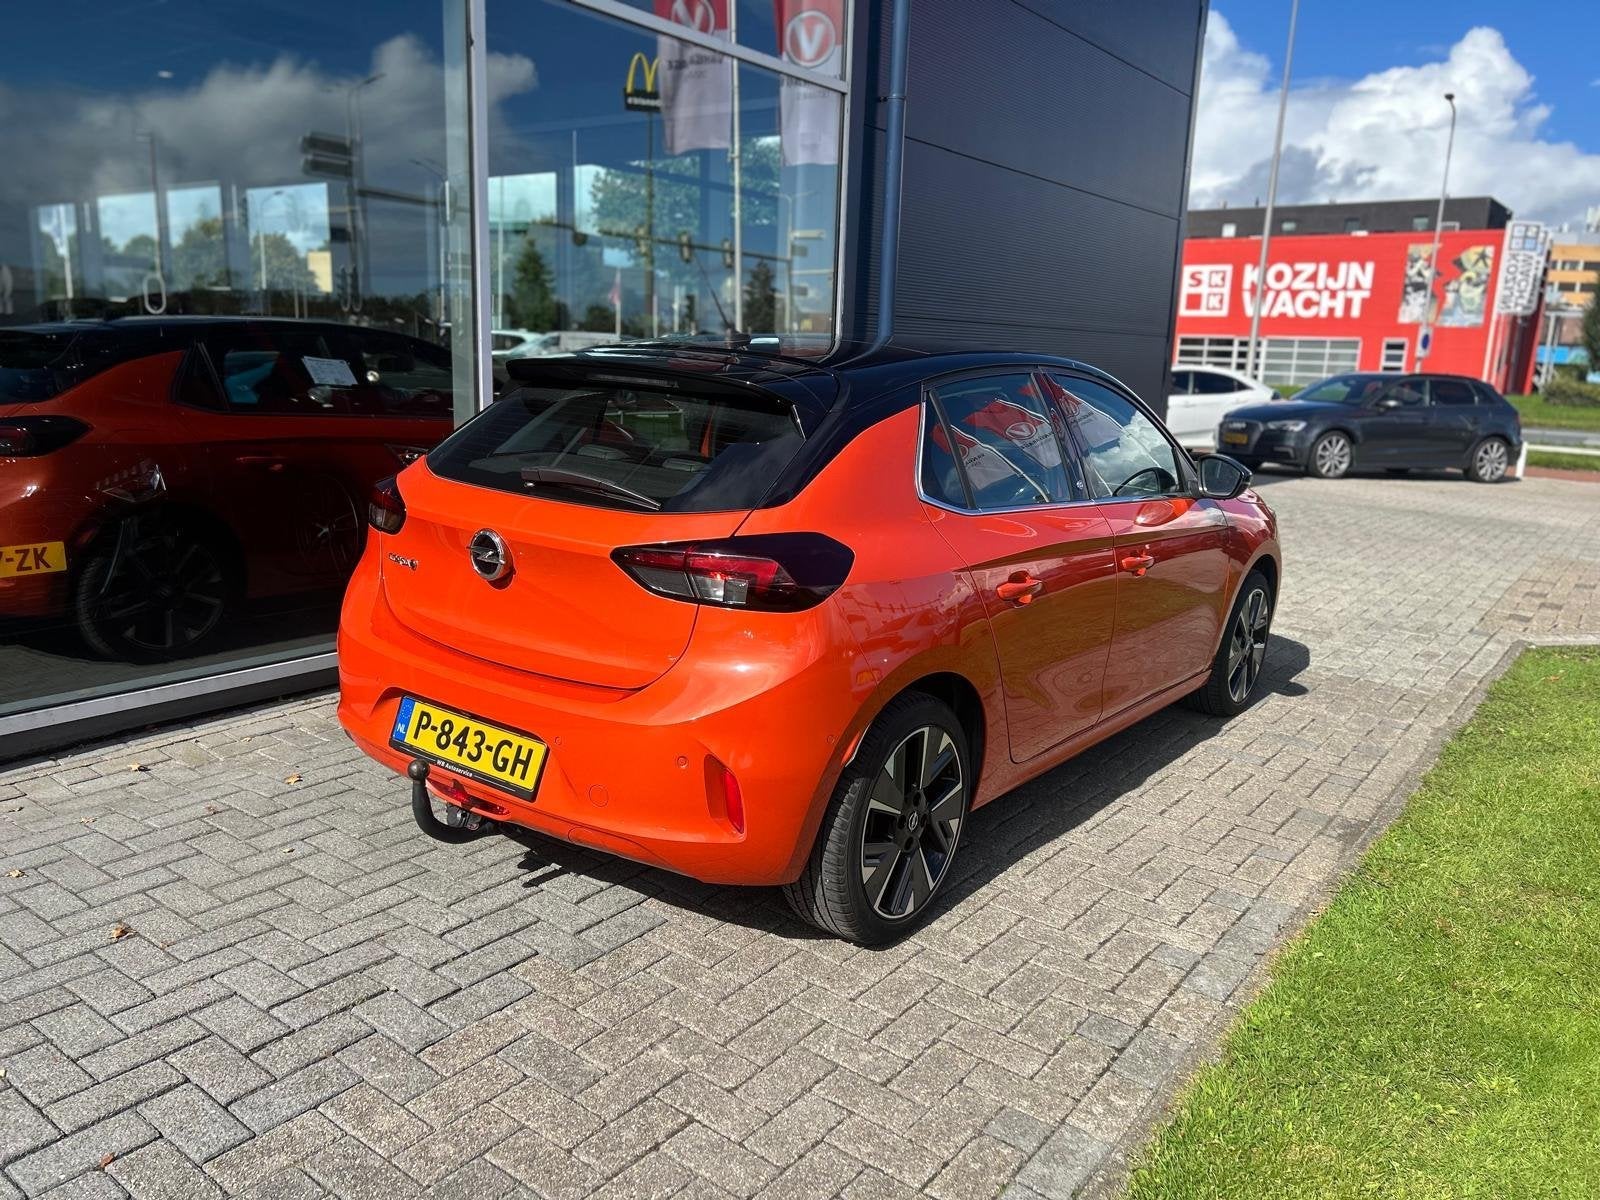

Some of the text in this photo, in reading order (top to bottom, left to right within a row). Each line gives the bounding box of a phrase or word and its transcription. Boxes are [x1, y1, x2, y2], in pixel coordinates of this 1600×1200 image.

[1242, 261, 1375, 290] KOZIJN
[1242, 289, 1371, 318] WACHT
[0, 547, 52, 571] -ZK
[396, 723, 406, 734] NL
[413, 710, 534, 780] P-843-GH
[445, 762, 473, 778] Autoservice
